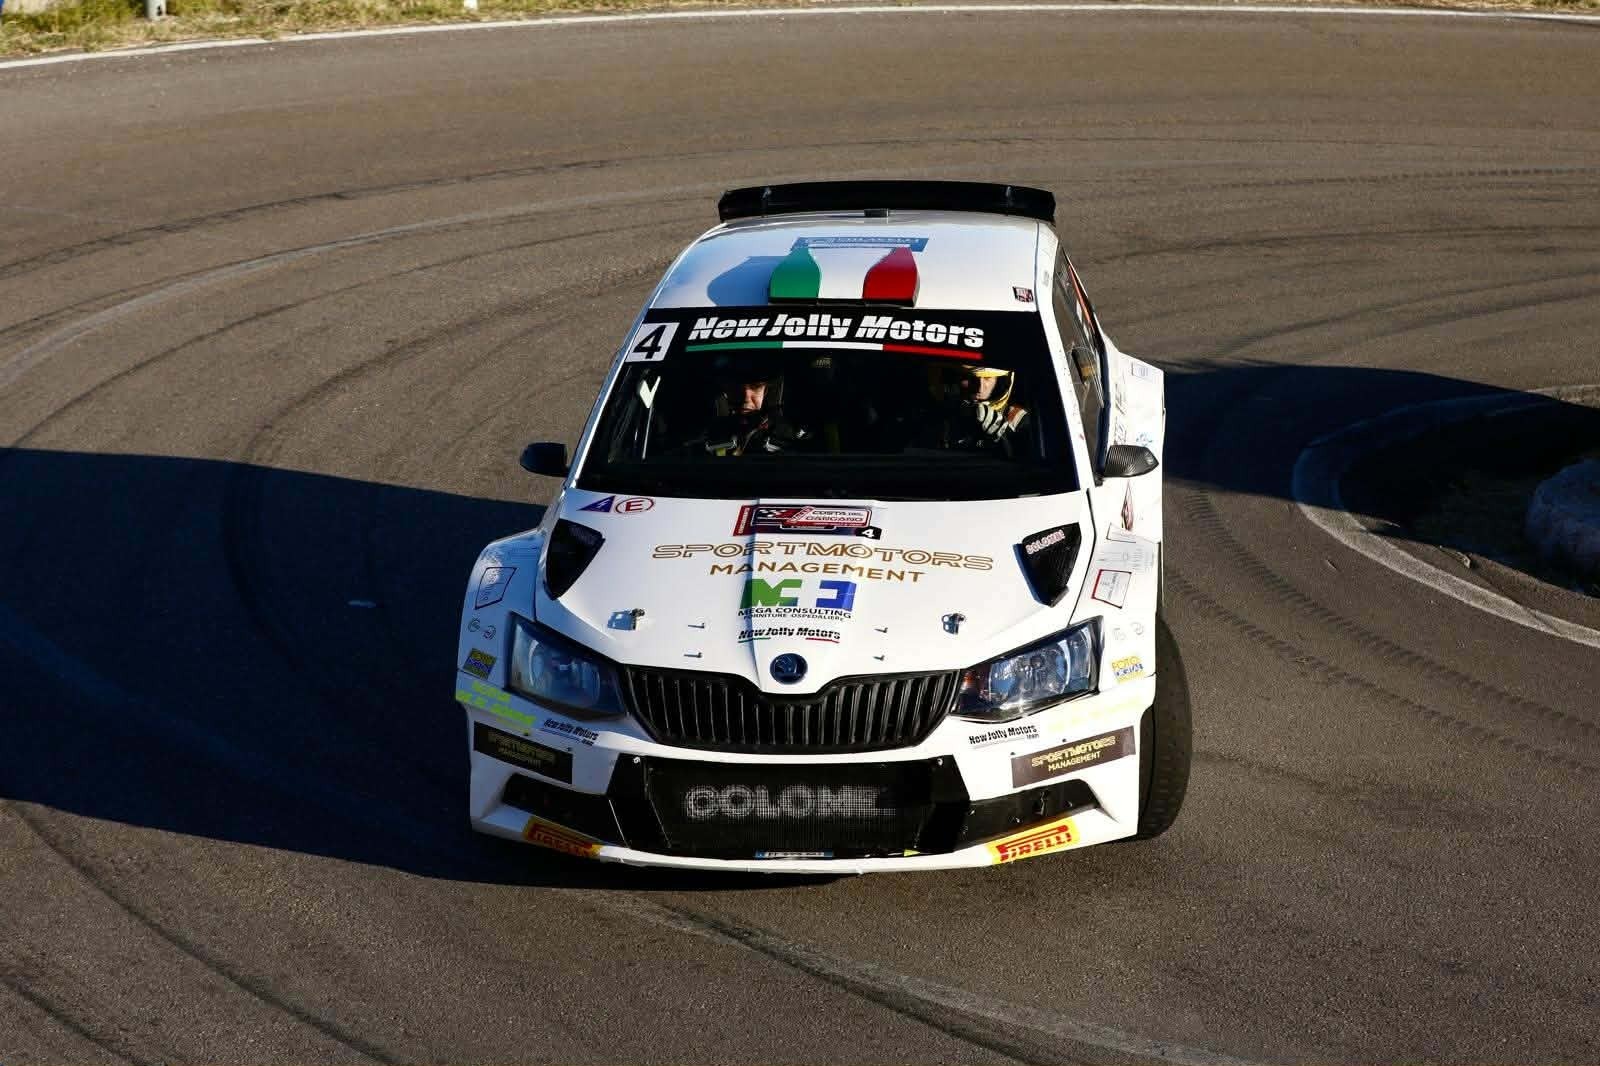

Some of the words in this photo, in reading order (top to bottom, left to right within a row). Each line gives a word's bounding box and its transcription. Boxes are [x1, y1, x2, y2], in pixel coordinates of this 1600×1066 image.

[688, 317, 769, 341] New
[766, 314, 853, 339] Jolly
[855, 316, 984, 348] Motors
[633, 325, 667, 359] 4
[862, 528, 875, 538] 4
[652, 541, 994, 571] SPORTMOTORS
[710, 561, 926, 583] MANAGEMENT
[738, 607, 773, 617] MEGA
[775, 607, 852, 619] CONSULTING
[738, 629, 766, 640] New
[765, 627, 795, 637] Jolly
[796, 627, 841, 640] Motors
[968, 735, 988, 745] New
[987, 729, 1008, 739] Jolly
[1008, 725, 1038, 737] Motors
[1048, 751, 1101, 771] MANAGEMENT
[996, 825, 1073, 863] PIRELLI
